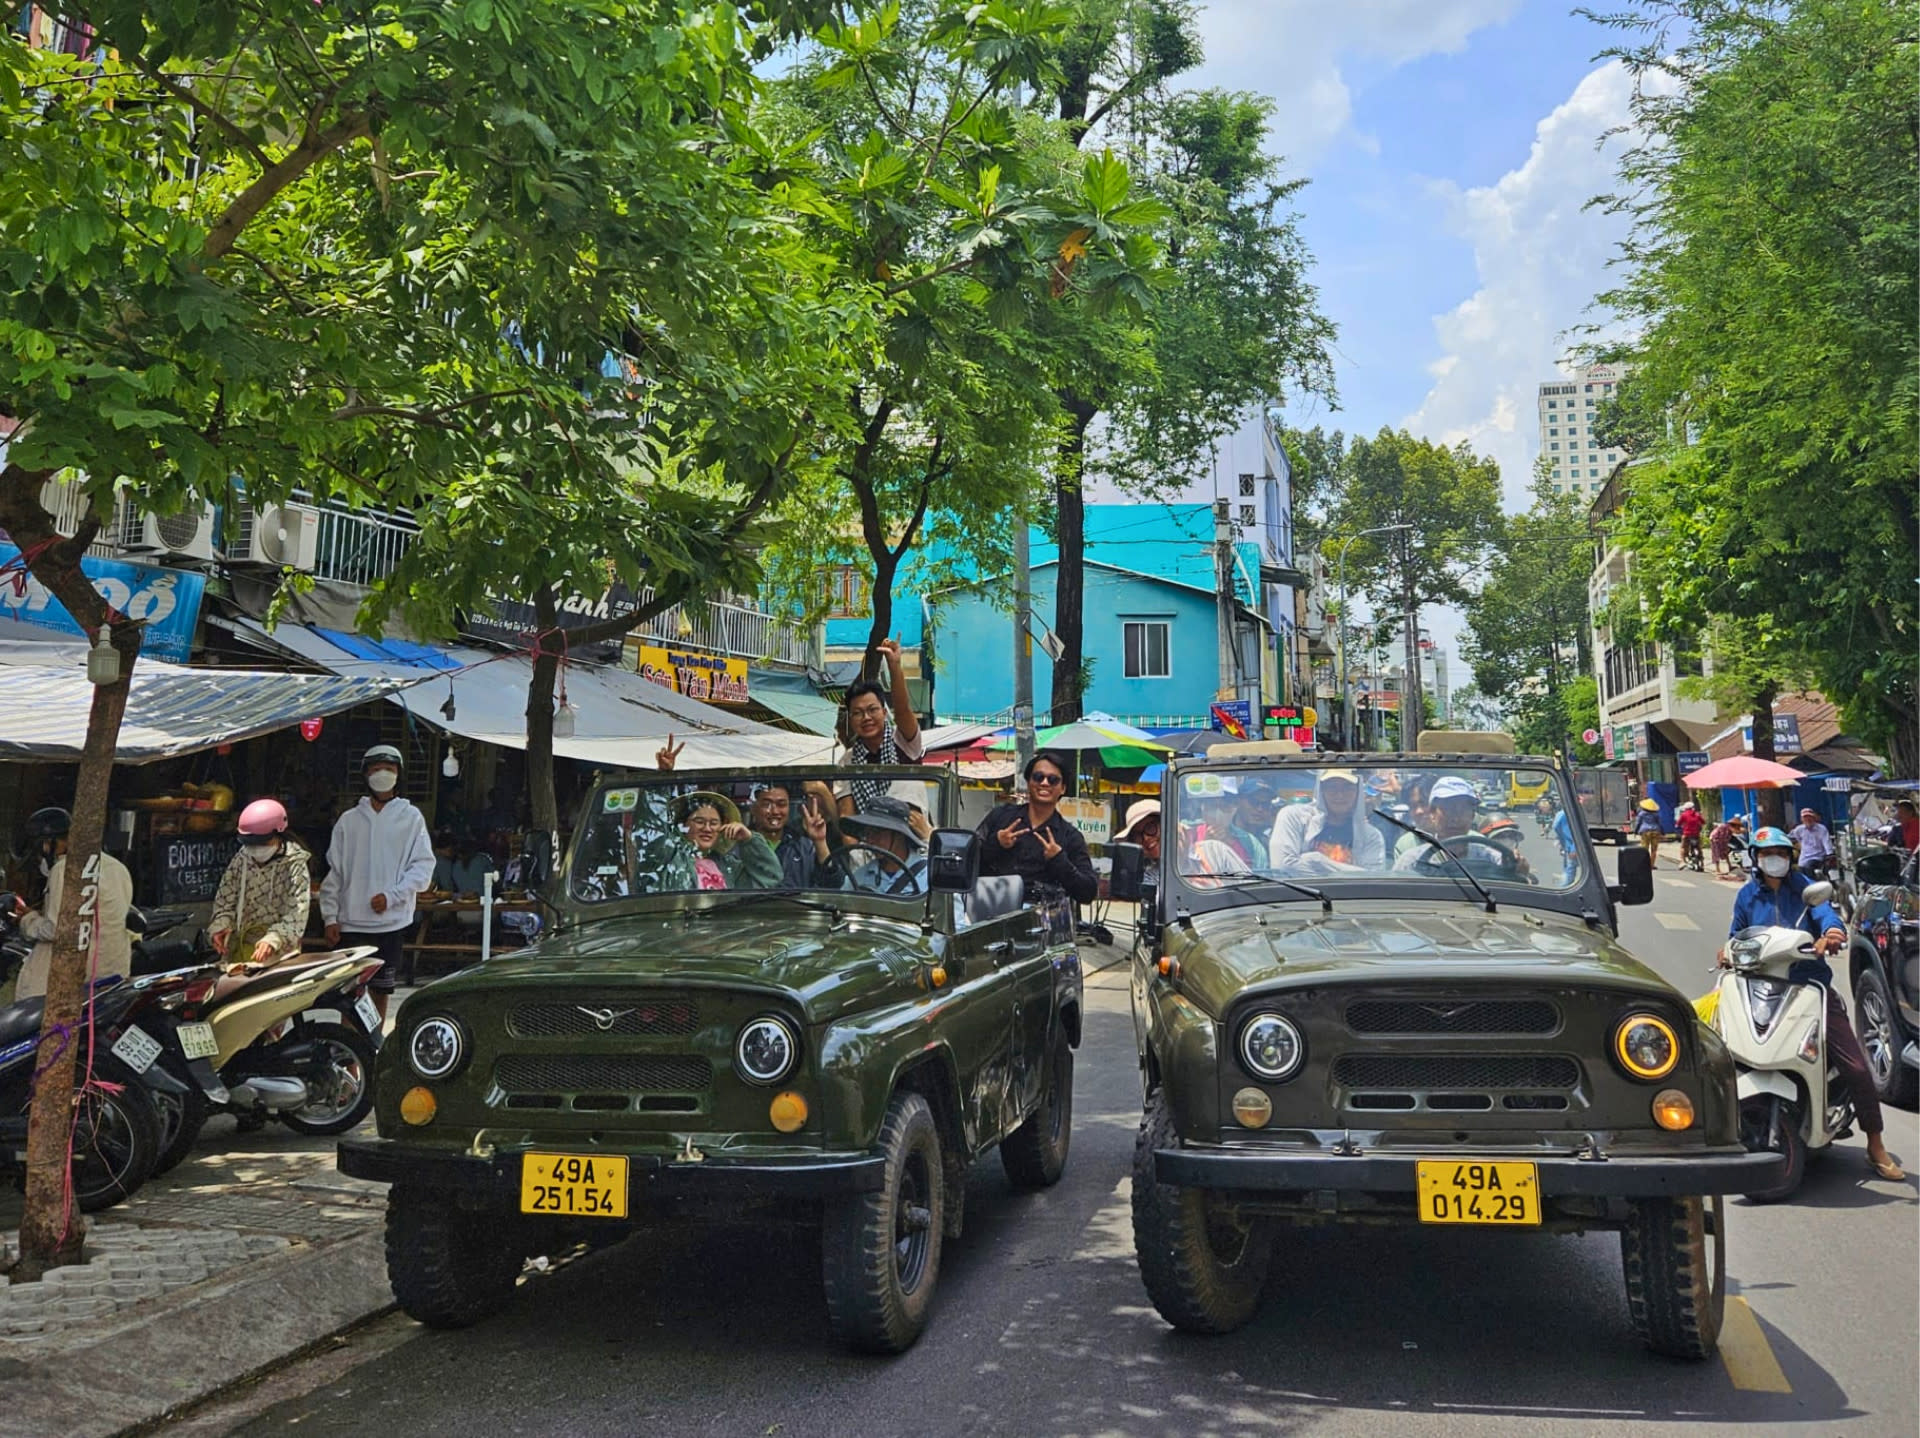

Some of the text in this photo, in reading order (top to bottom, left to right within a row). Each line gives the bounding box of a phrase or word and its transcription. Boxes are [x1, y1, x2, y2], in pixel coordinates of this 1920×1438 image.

[678, 667, 709, 699] Văn
[712, 671, 749, 702] Minh
[552, 1158, 595, 1184] 49A
[1452, 1165, 1502, 1190] 49A
[533, 1186, 613, 1213] 251.54
[1433, 1194, 1525, 1220] 014.29
